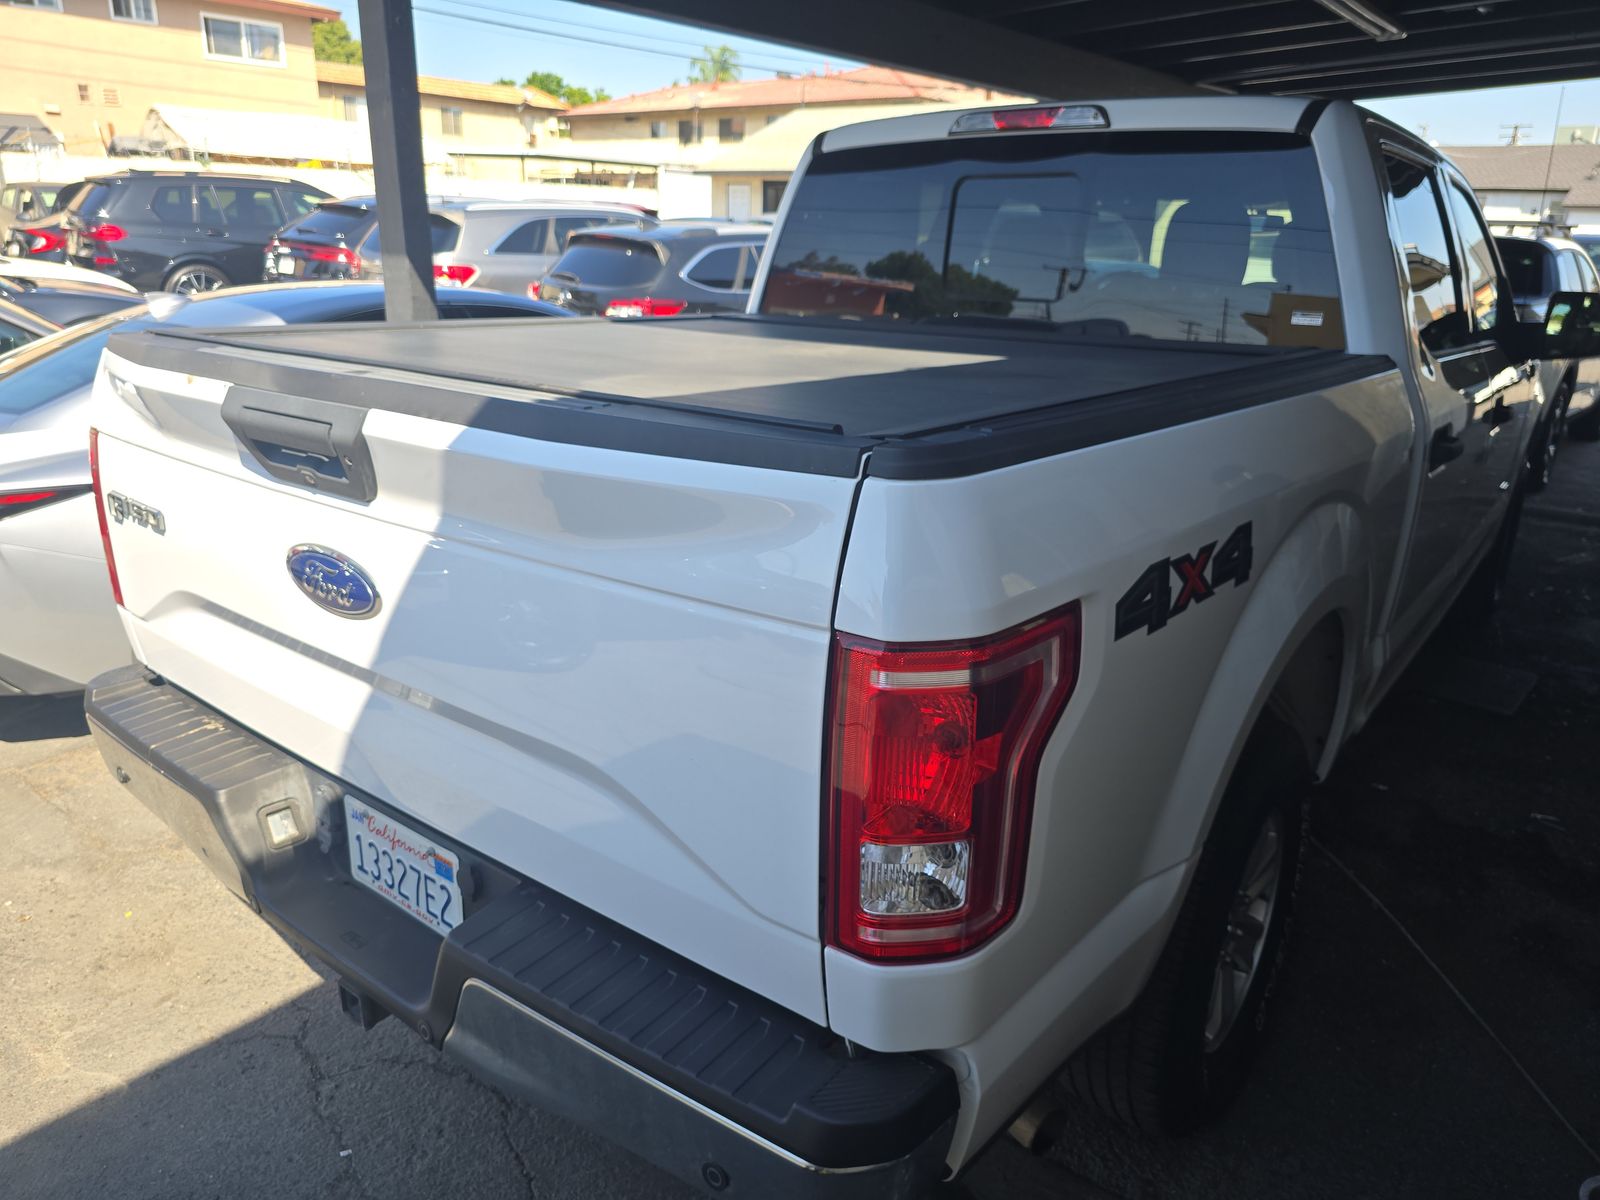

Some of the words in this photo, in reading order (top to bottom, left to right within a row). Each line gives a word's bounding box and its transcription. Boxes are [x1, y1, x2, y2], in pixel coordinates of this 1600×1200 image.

[302, 560, 354, 608] Ford
[367, 815, 436, 868] California
[355, 834, 454, 929] 13327E2
